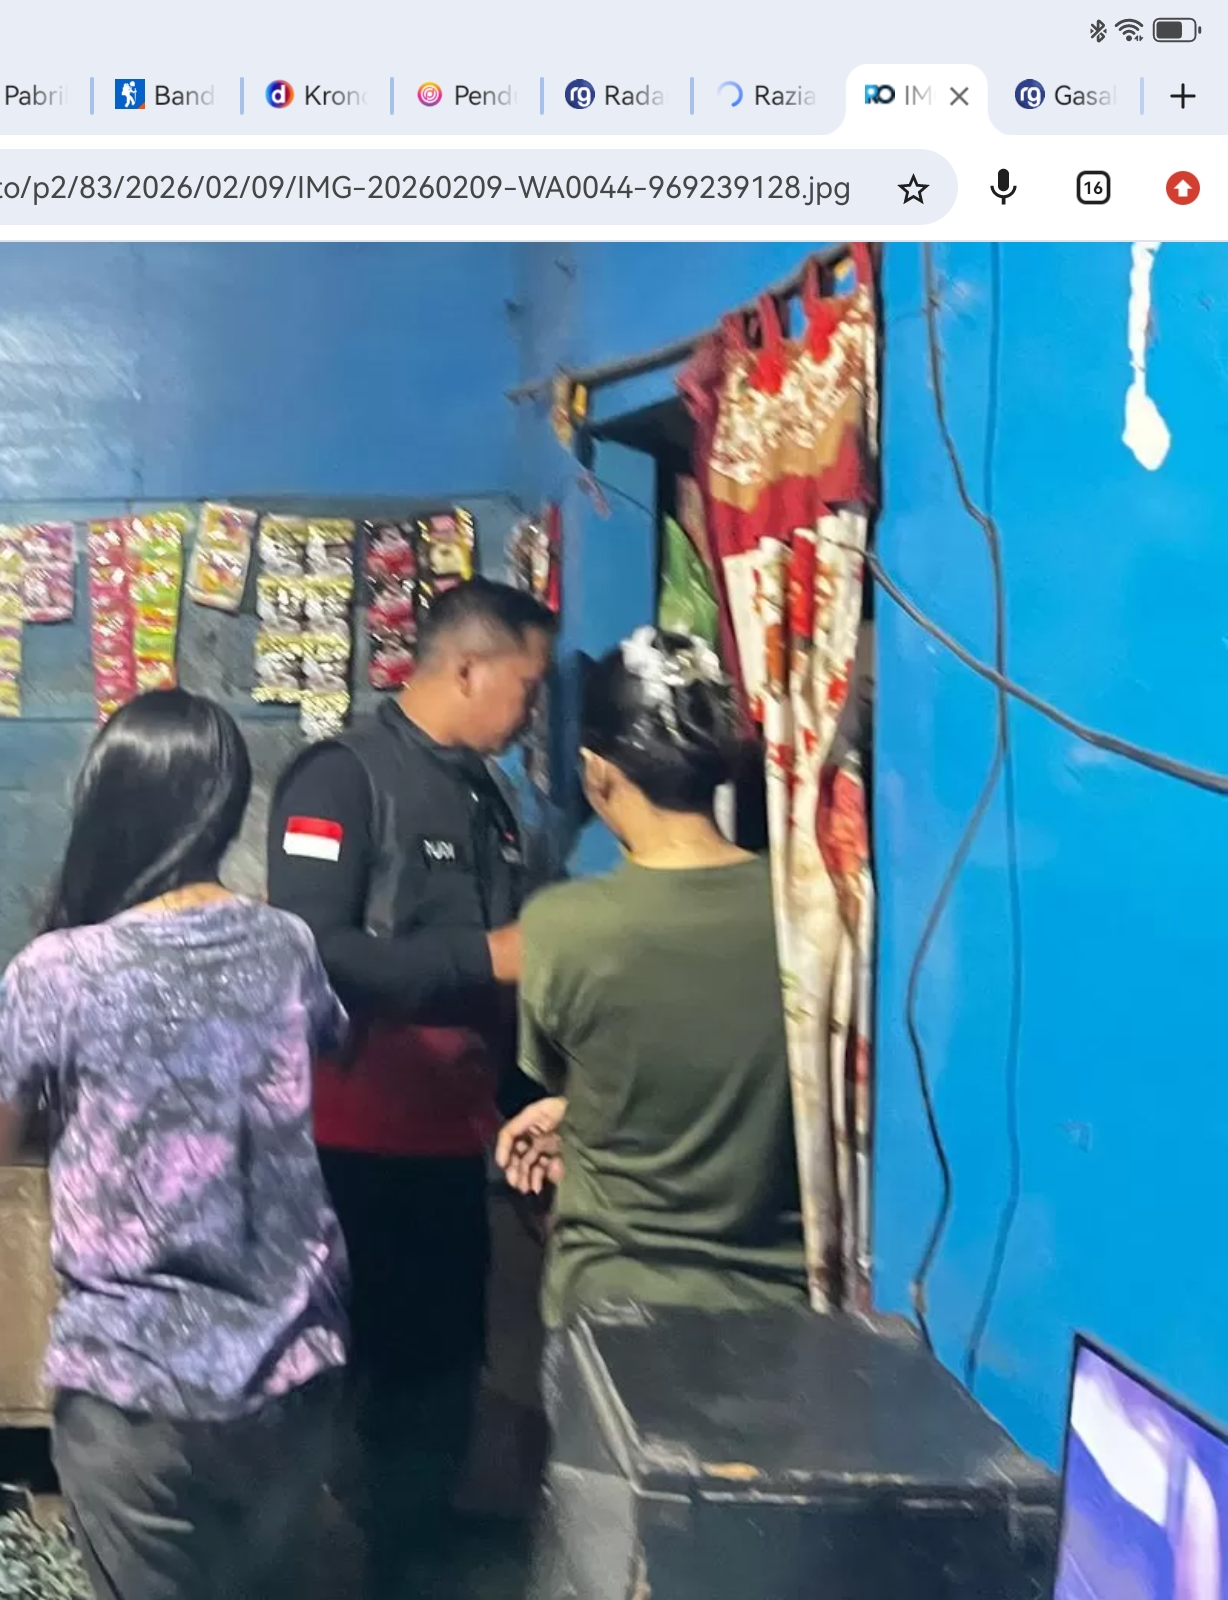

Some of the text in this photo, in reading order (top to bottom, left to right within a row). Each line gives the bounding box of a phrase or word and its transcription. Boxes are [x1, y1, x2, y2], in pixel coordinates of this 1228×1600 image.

[155, 84, 215, 107] Band
[755, 84, 816, 107] Razia
[905, 84, 935, 106] IM
[1083, 181, 1103, 195] 16
